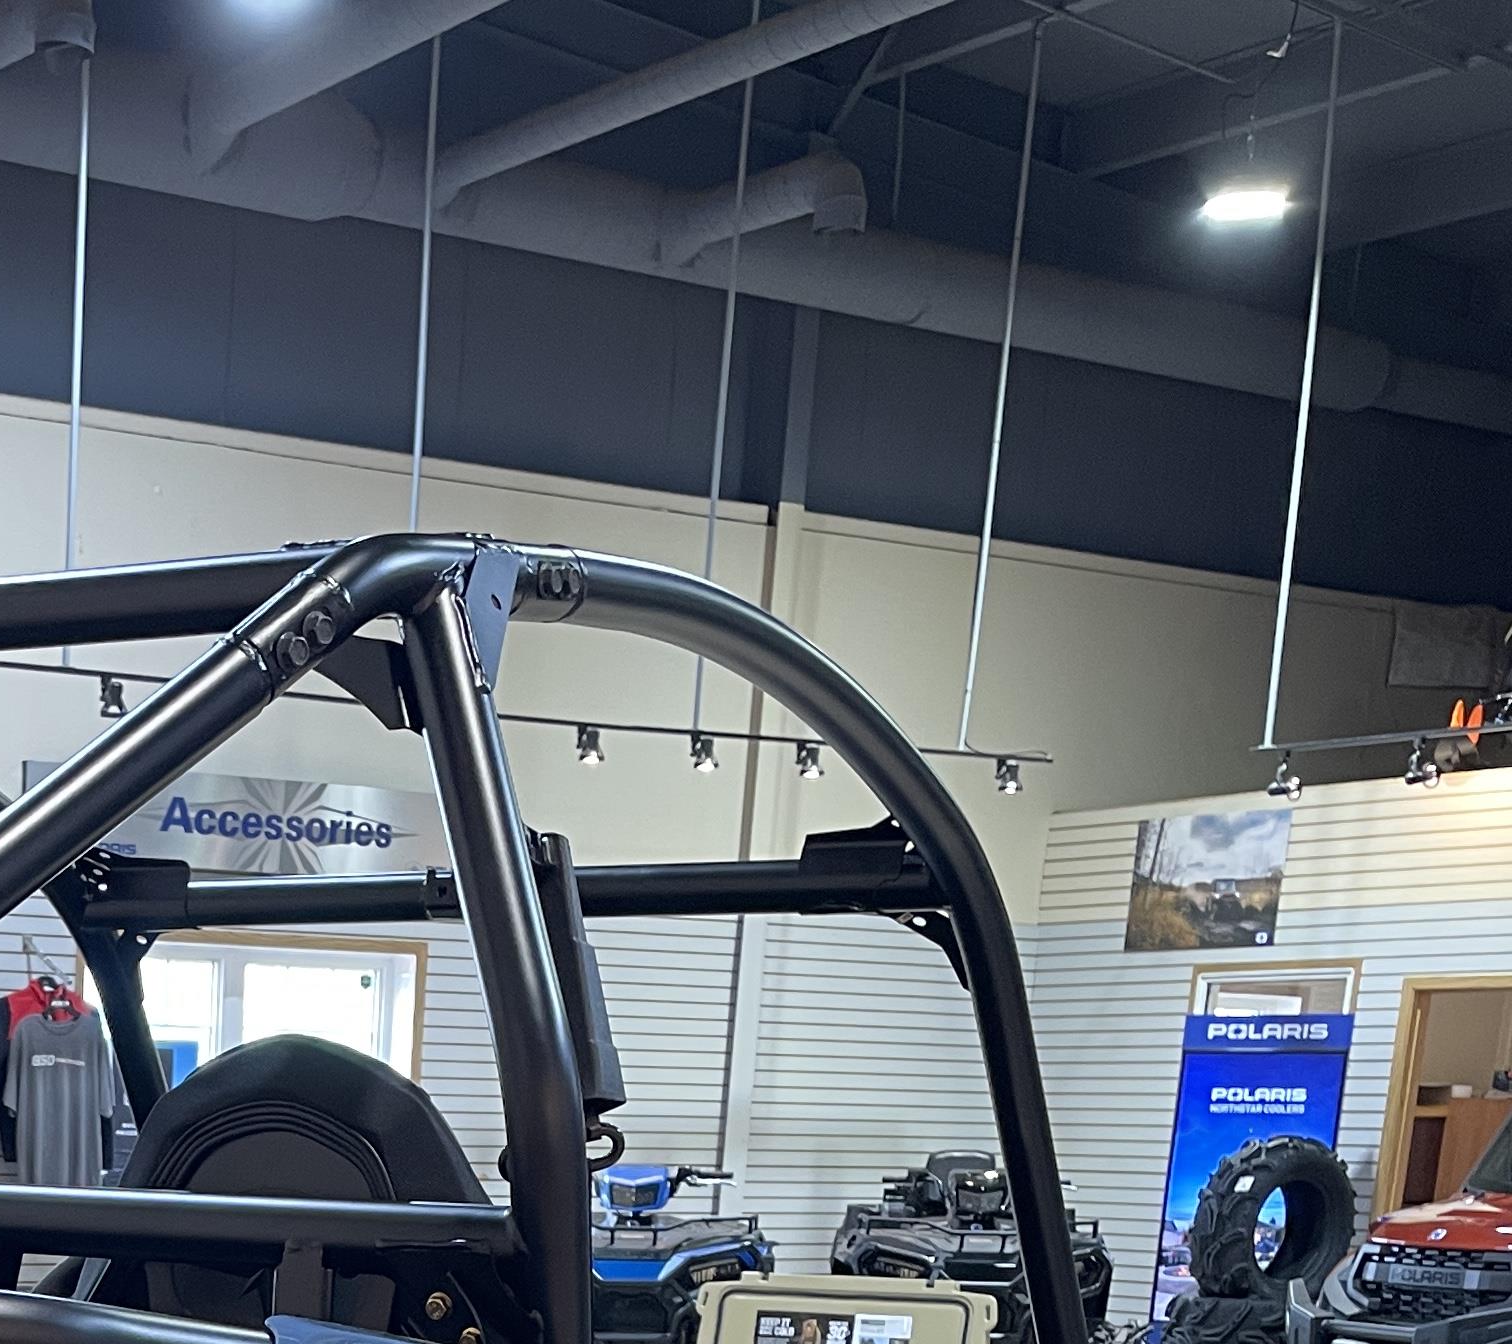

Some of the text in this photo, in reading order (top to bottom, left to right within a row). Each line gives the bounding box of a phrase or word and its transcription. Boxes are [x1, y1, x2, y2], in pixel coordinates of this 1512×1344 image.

[159, 796, 393, 849] Accessories
[1206, 1022, 1330, 1041] POLARIS
[1210, 1086, 1308, 1103] POLARIS
[1390, 1266, 1462, 1286] POLARIS
